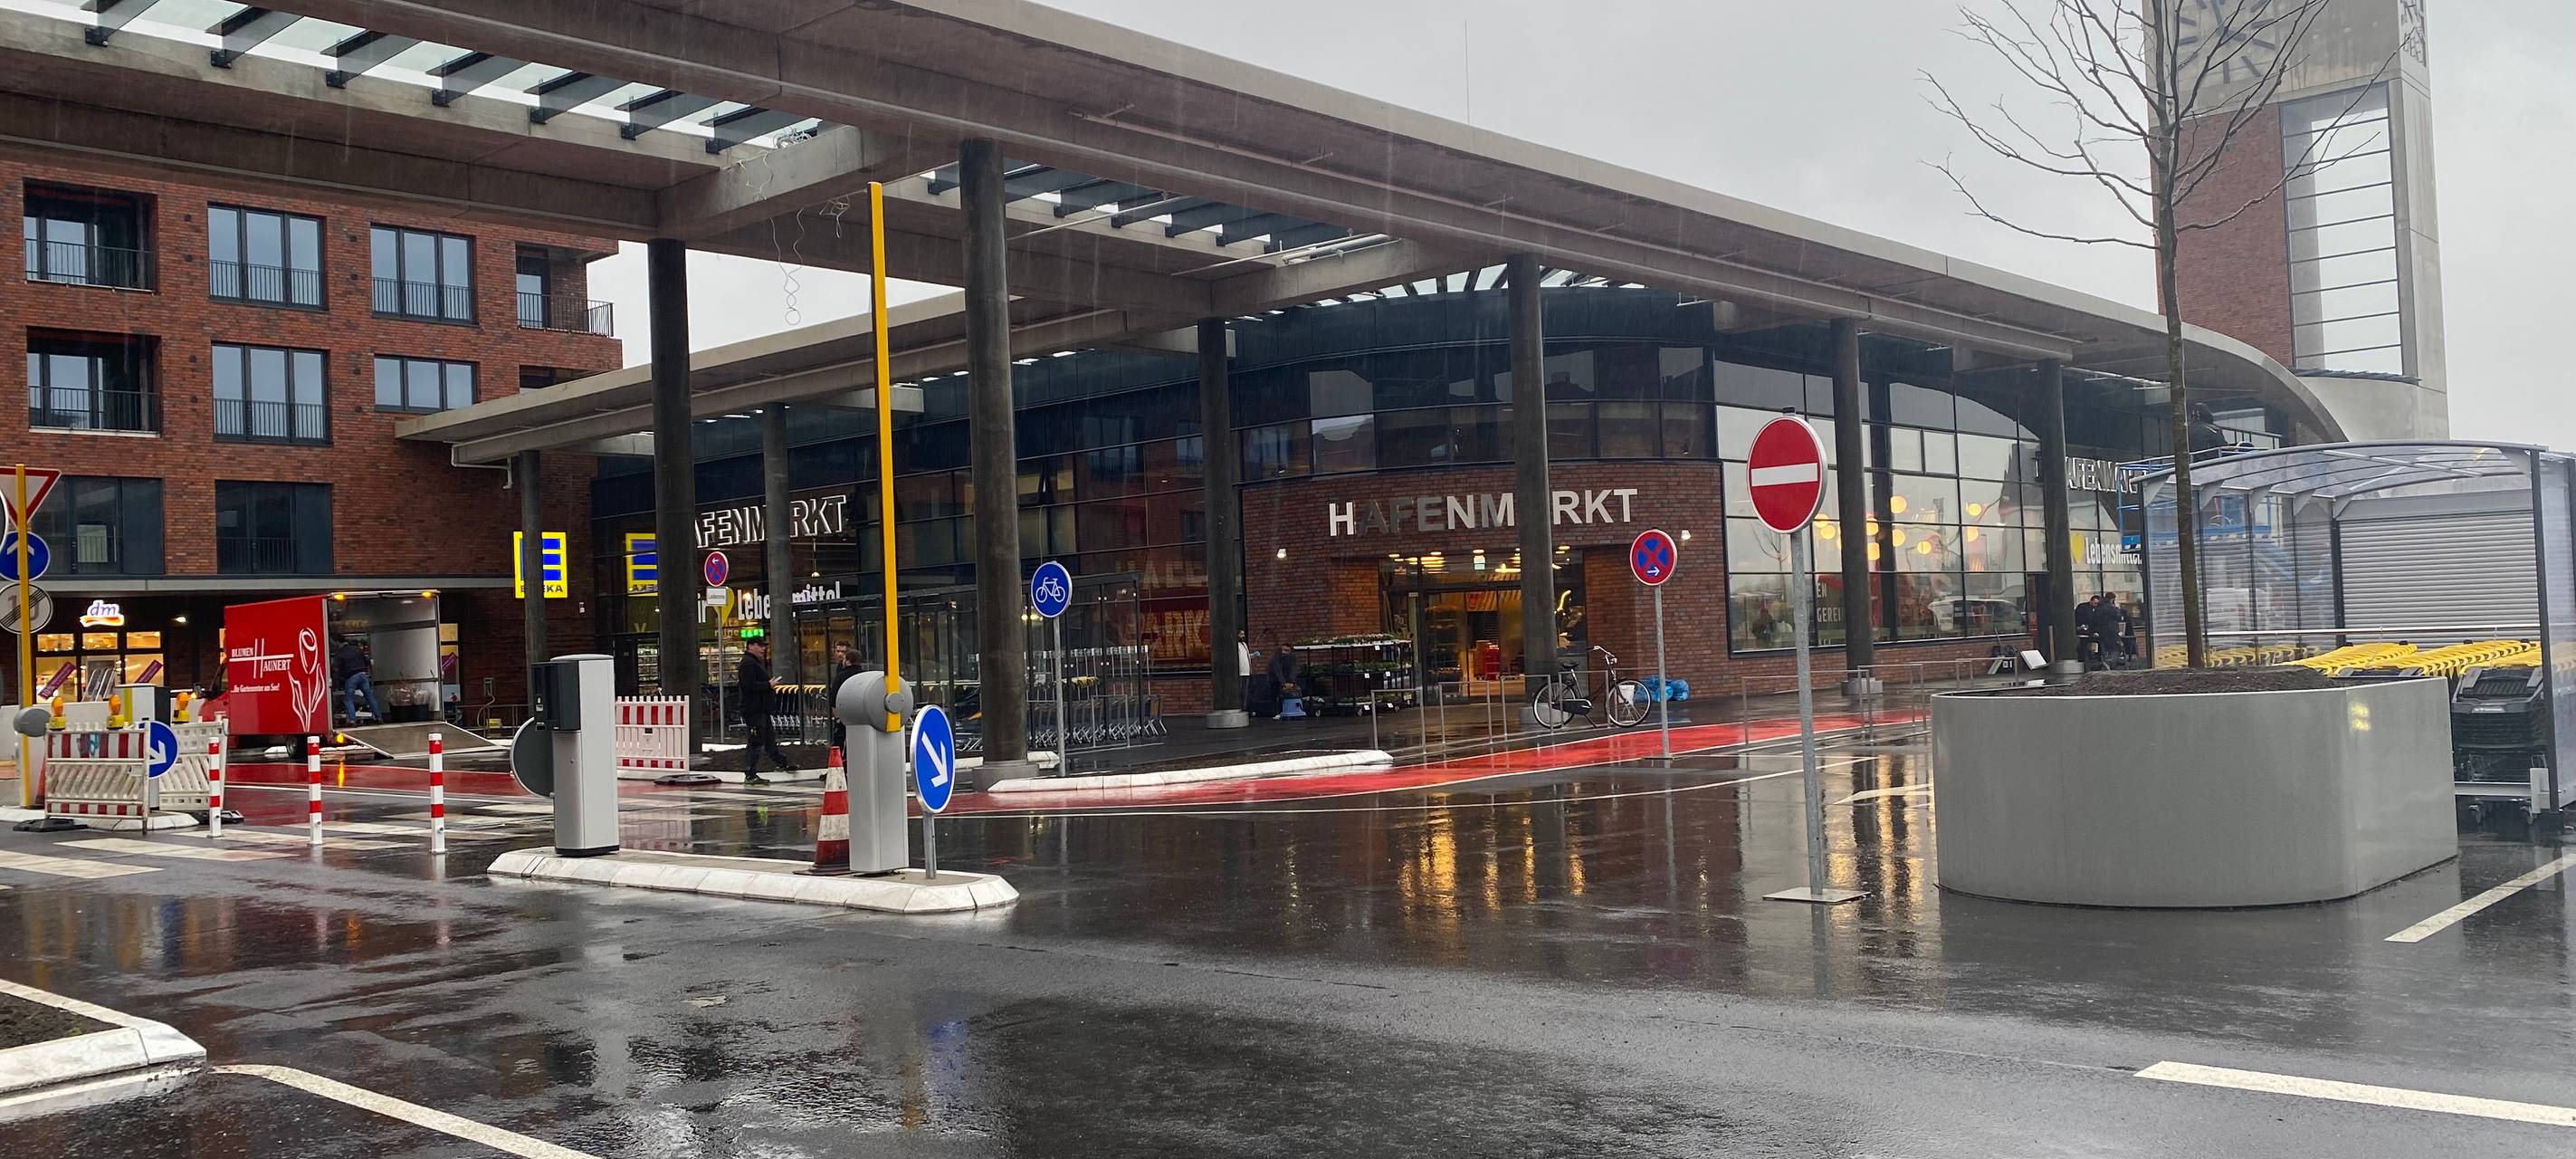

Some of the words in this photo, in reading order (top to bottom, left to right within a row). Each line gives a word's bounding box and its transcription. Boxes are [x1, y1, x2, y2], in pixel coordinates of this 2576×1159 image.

[1329, 489, 1638, 536] HAFENMRKT
[90, 601, 117, 617] dm
[231, 647, 254, 658] BLUMEN
